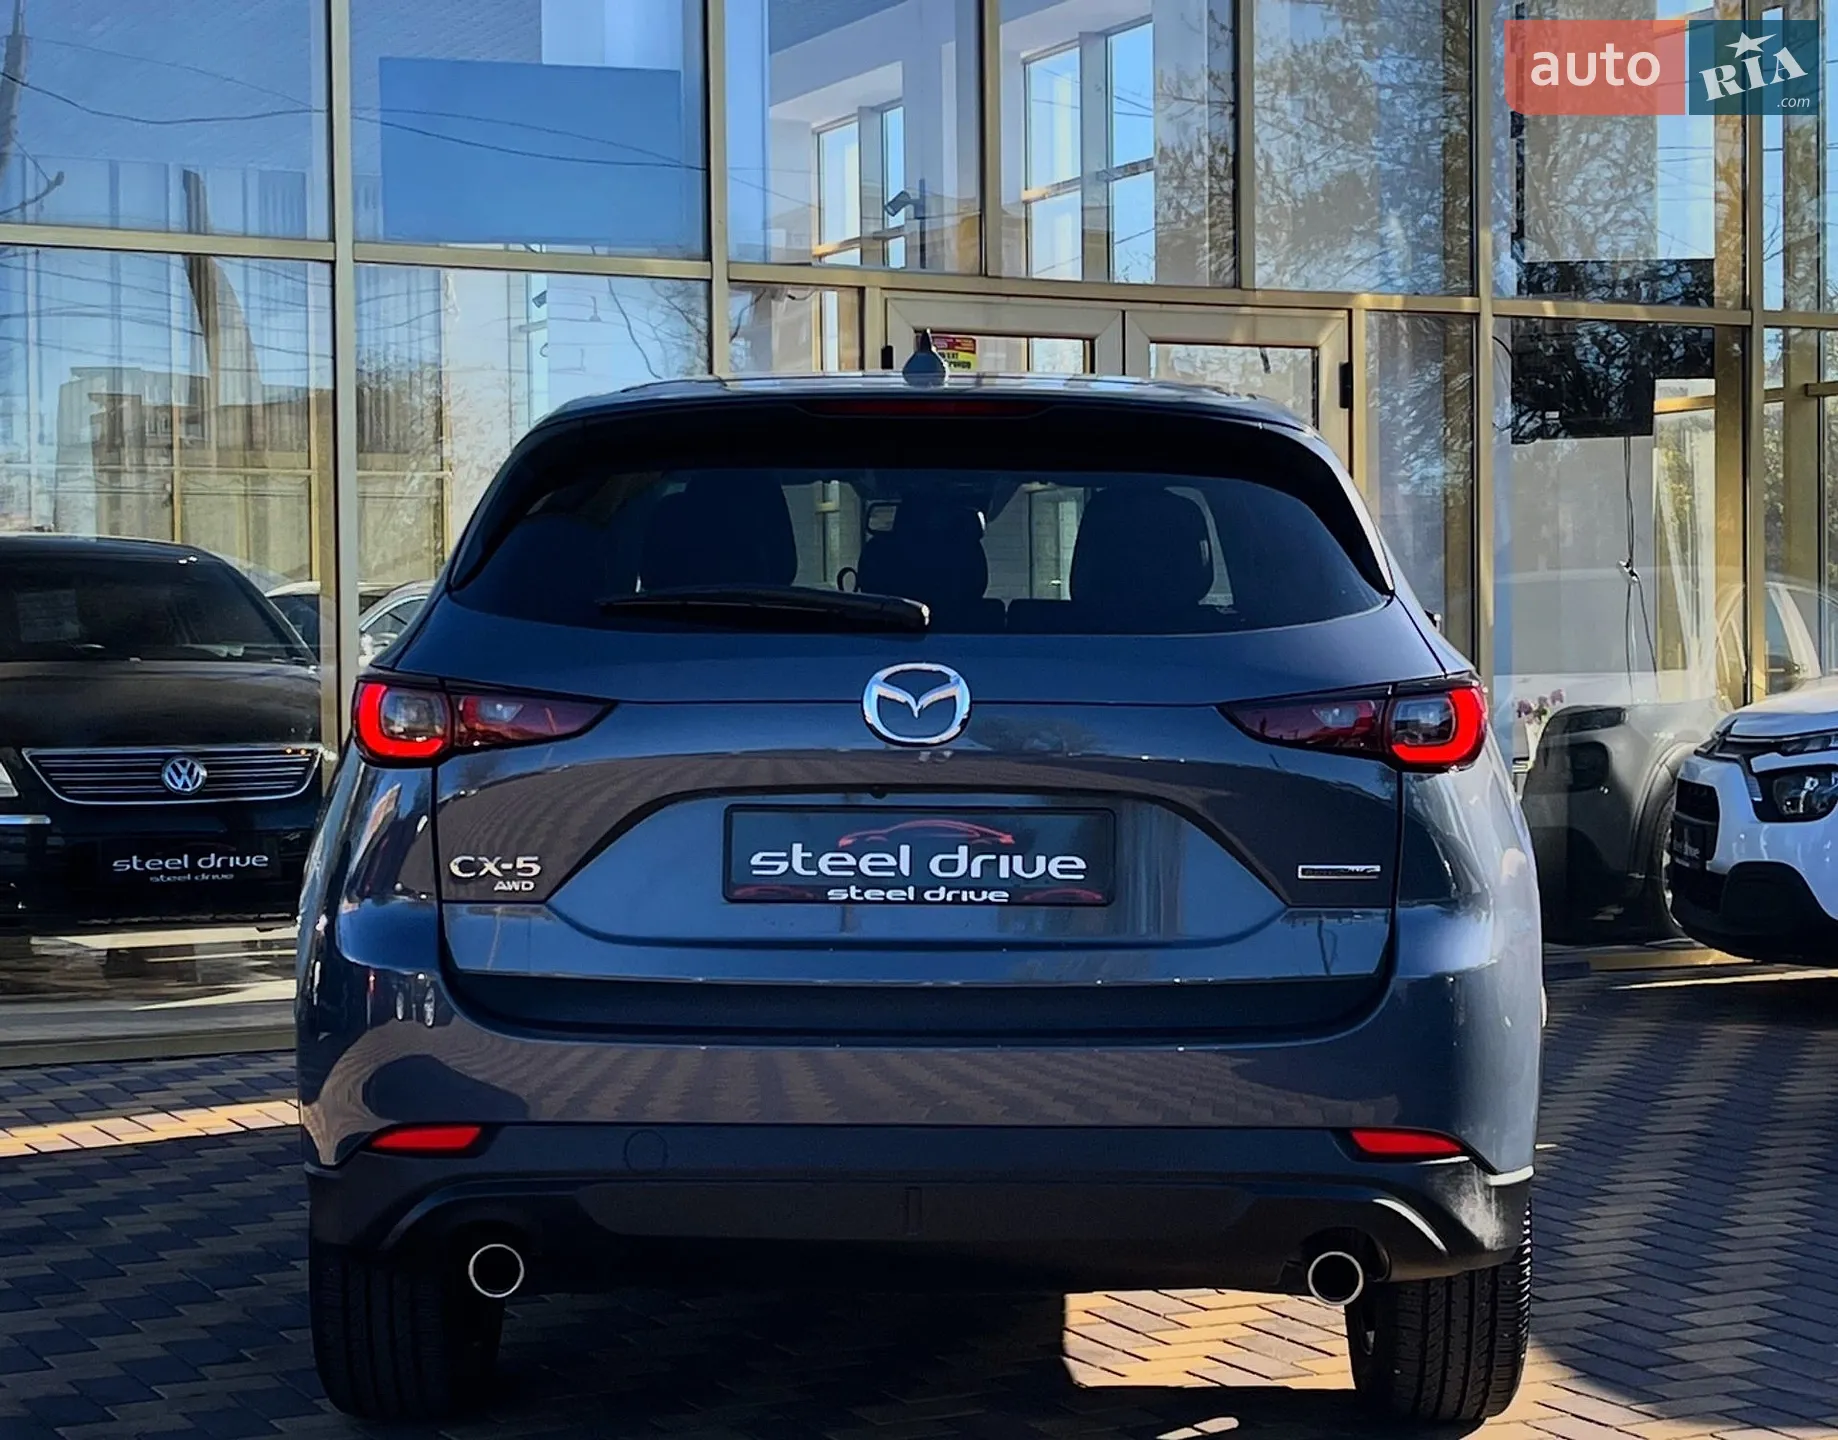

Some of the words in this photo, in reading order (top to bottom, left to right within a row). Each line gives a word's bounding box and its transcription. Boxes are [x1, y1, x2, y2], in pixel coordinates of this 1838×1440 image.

[111, 854, 190, 872] steel
[197, 852, 269, 869] drive
[448, 855, 542, 878] CX-5
[749, 842, 911, 878] steel
[928, 844, 1087, 881] drive
[149, 872, 191, 883] steel
[194, 872, 235, 881] drive
[493, 880, 535, 891] AWD
[826, 885, 915, 901] steel
[922, 886, 1010, 903] drive
